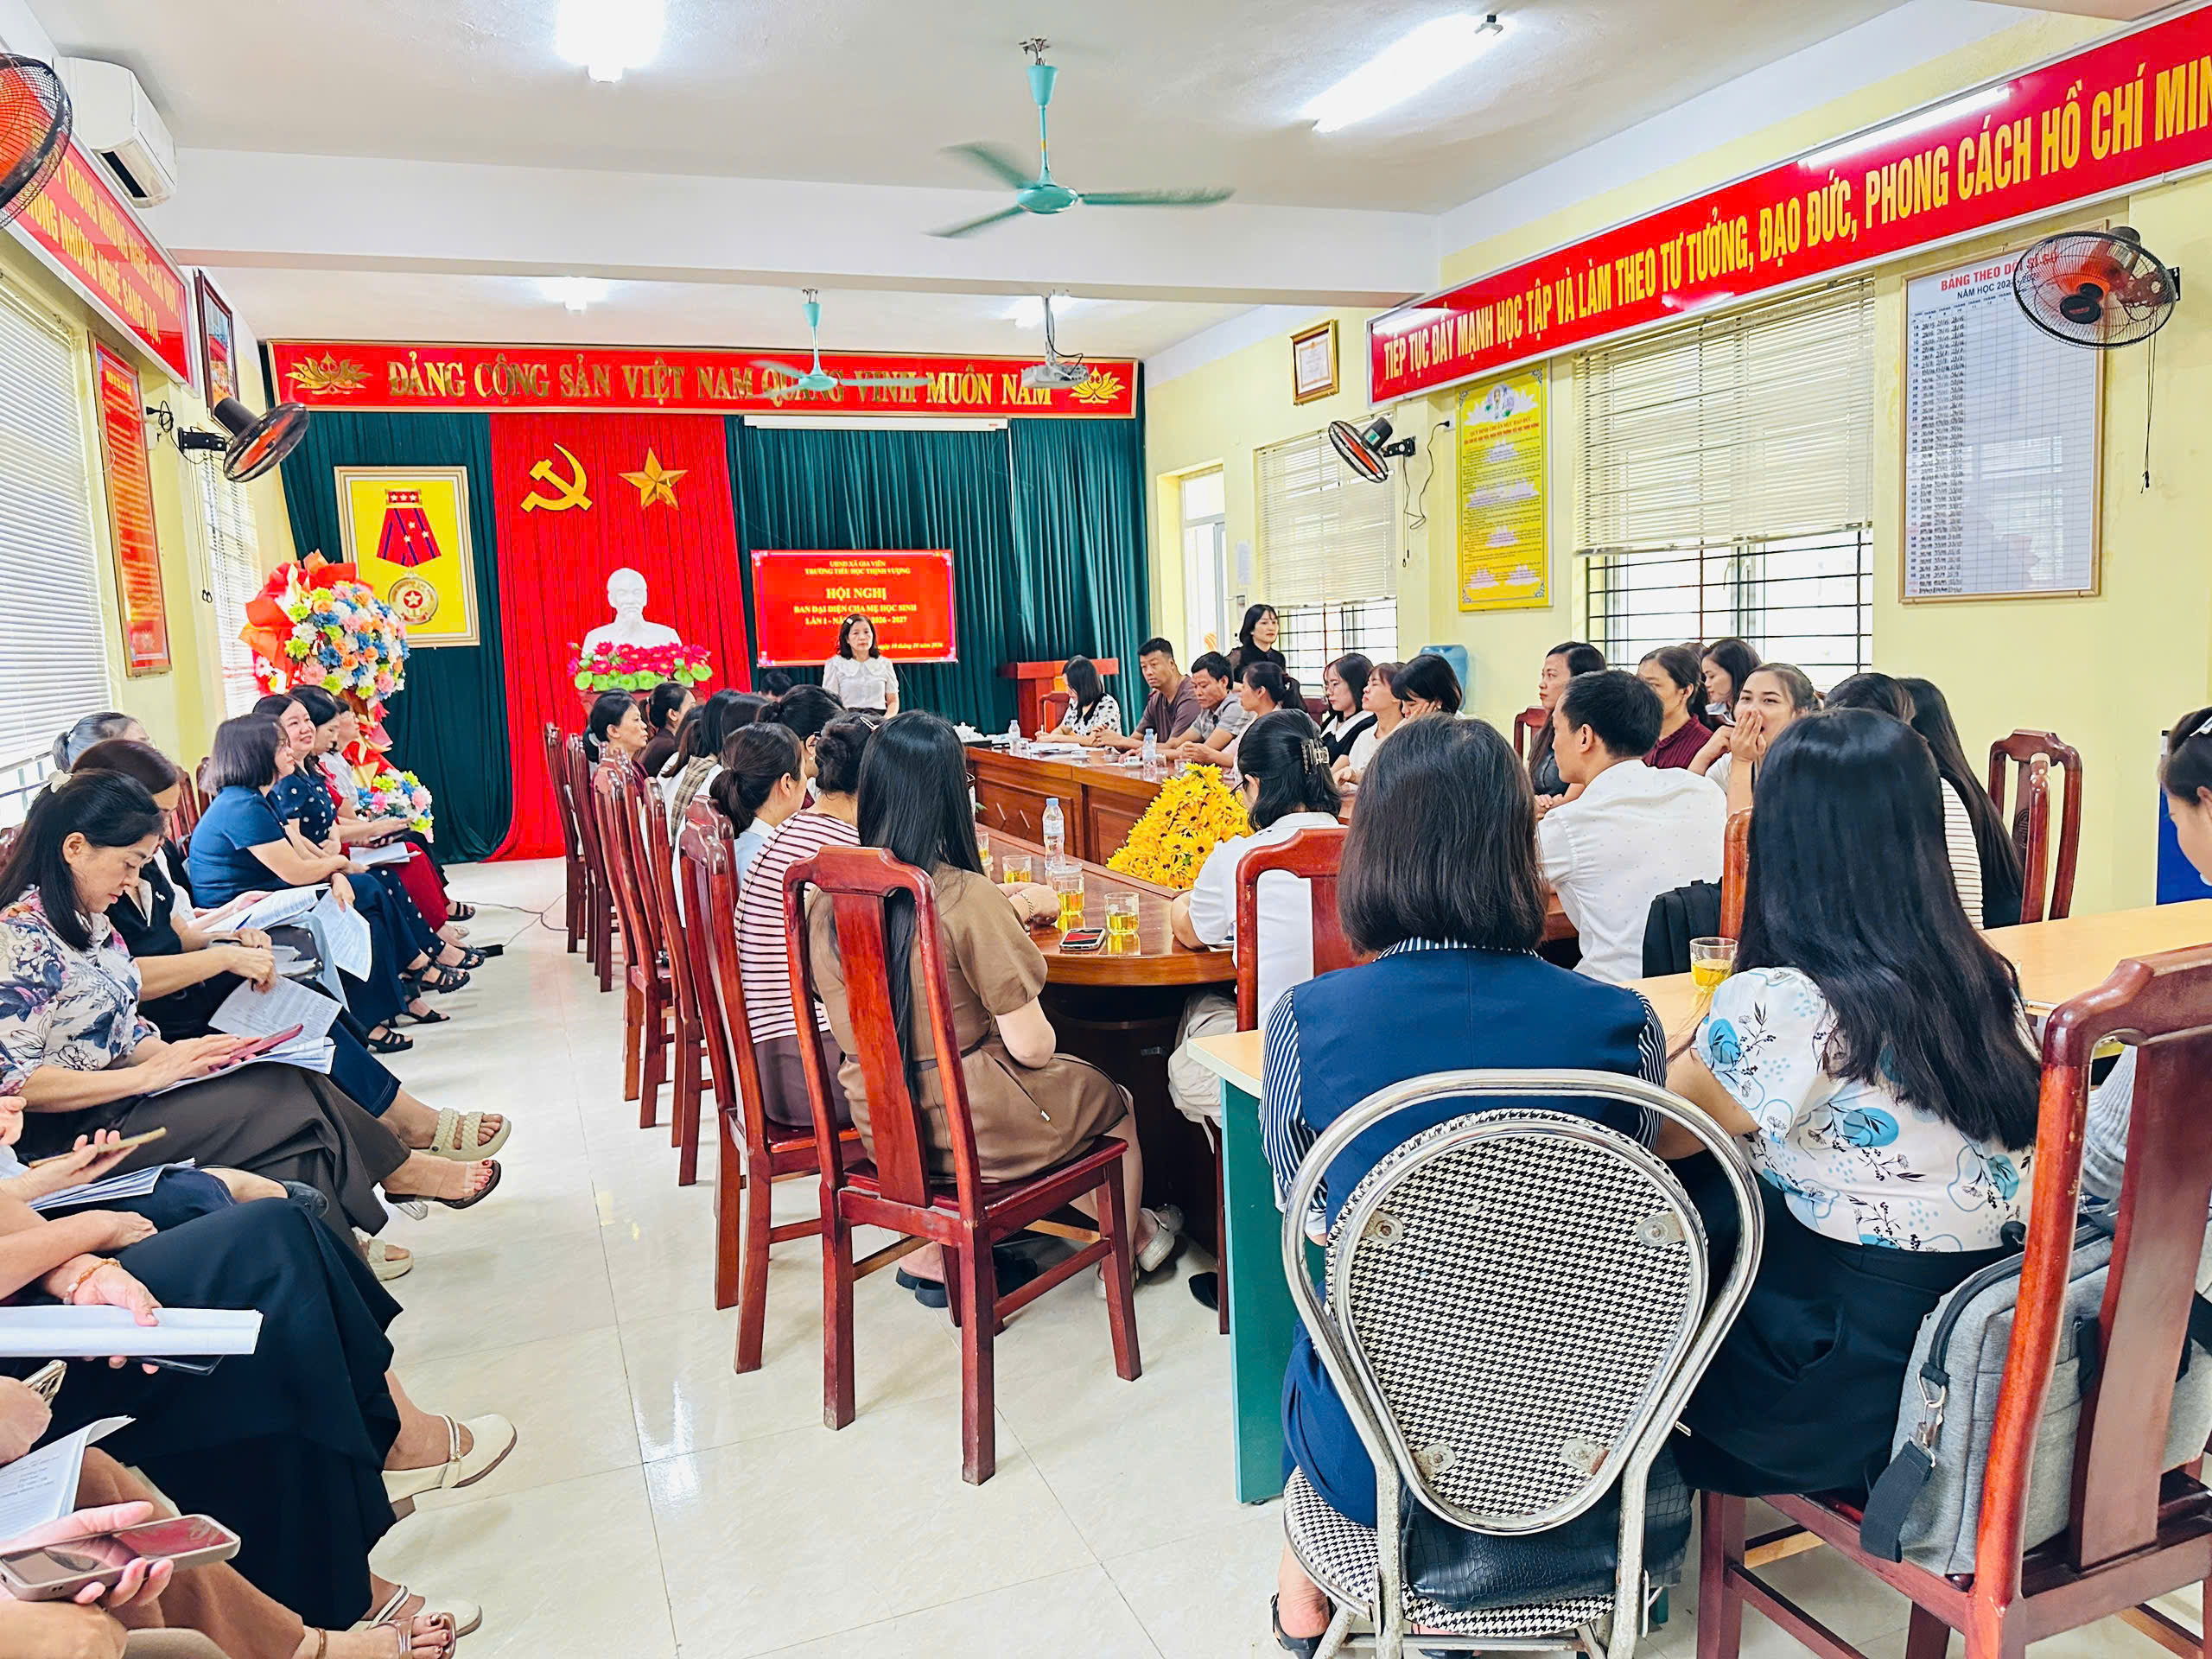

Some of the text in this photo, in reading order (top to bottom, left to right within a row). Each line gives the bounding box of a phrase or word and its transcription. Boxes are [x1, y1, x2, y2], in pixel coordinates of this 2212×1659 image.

[1383, 327, 1407, 381] TIẾP
[1408, 328, 1430, 378] TỤC
[1431, 302, 1454, 364] ĐẨY
[1457, 306, 1493, 362] MẠNH
[1497, 299, 1522, 349] HỌC
[1525, 278, 1553, 340] TẬP
[1555, 266, 1575, 326] VÀ
[1578, 258, 1611, 319] LÀM
[1615, 247, 1656, 307] THEO
[1660, 233, 1685, 290] TƯ
[1685, 207, 1754, 284] TƯỞNG,
[1758, 196, 1801, 268] ĐẠO
[1807, 168, 1858, 248] ĐỨC,
[1865, 145, 1949, 230] PHONG
[1957, 115, 2032, 201] CÁCH
[2041, 79, 2083, 176] HỒ
[2090, 63, 2145, 161] CHÍ
[60, 208, 97, 282] NHỮNG
[1941, 273, 1970, 291] BẢNG
[1974, 266, 2000, 283] THEO
[1957, 289, 1975, 300] NĂM
[1977, 283, 1995, 295] HỌC
[1997, 278, 2014, 290] 202
[387, 350, 466, 397] ĐẢNG
[474, 352, 550, 404] CỘNG
[561, 353, 611, 398] SẢN
[621, 357, 684, 405] VIỆT
[697, 365, 753, 401] NAM
[855, 370, 916, 404] VINH
[925, 363, 992, 405] MUÔN
[804, 567, 833, 575] TRƯỜNG
[850, 568, 864, 576] HỌC
[866, 568, 887, 576] THỊNH
[887, 567, 911, 576] VƯỢNG
[826, 586, 887, 601] HỘI NGHỊ
[794, 603, 917, 614] BAN ĐẠI DIỆN CHA MẸ HỌC SINH
